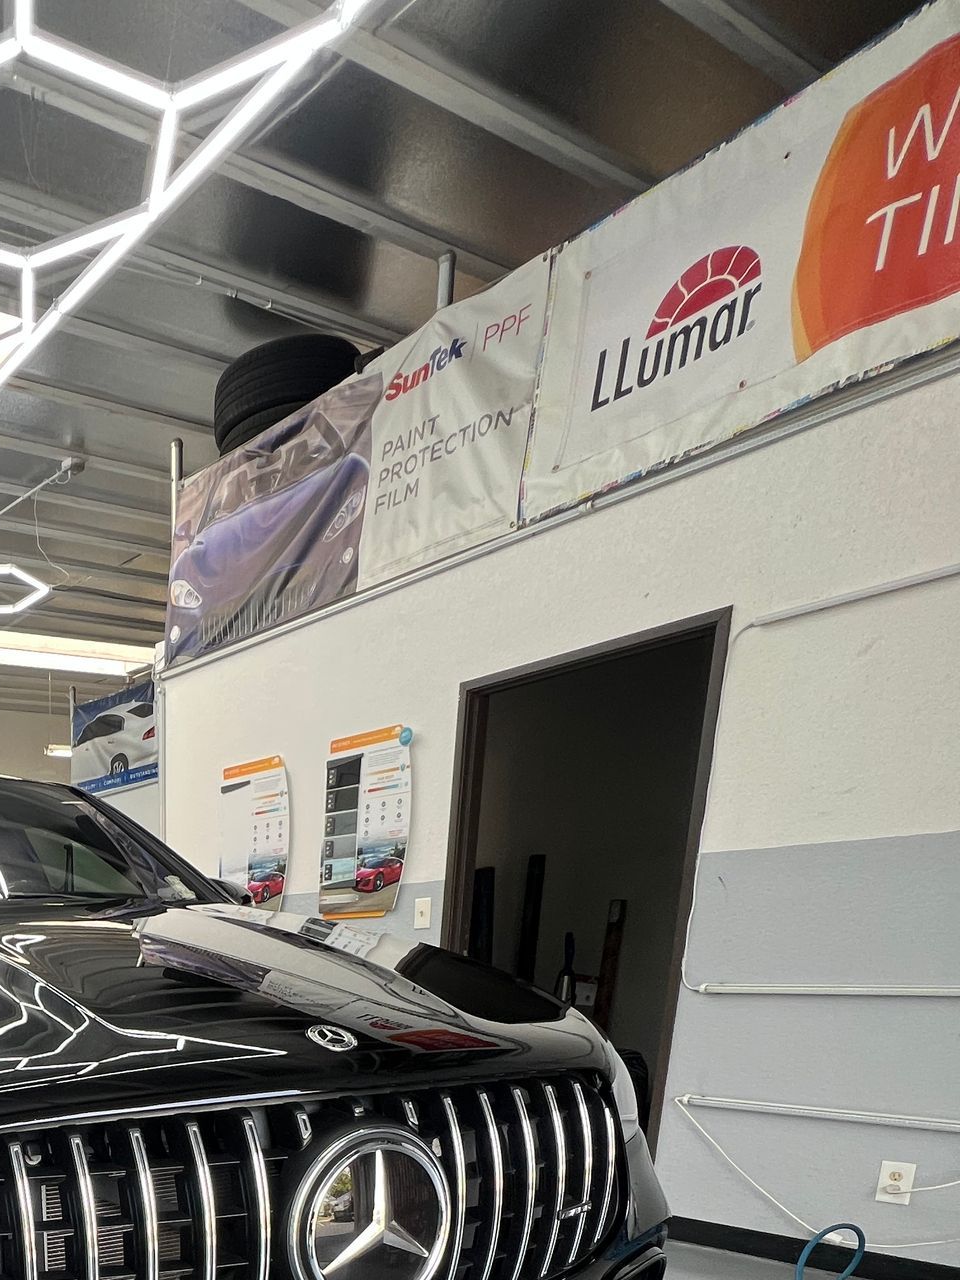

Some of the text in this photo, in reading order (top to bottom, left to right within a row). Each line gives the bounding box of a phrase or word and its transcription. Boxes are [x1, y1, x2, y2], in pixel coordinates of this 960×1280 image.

[385, 303, 532, 401] SunTek PPF
[591, 282, 762, 412] LLumar
[378, 407, 513, 488] PROTECTION
[382, 414, 440, 462] PAINT
[374, 478, 419, 515] FILM
